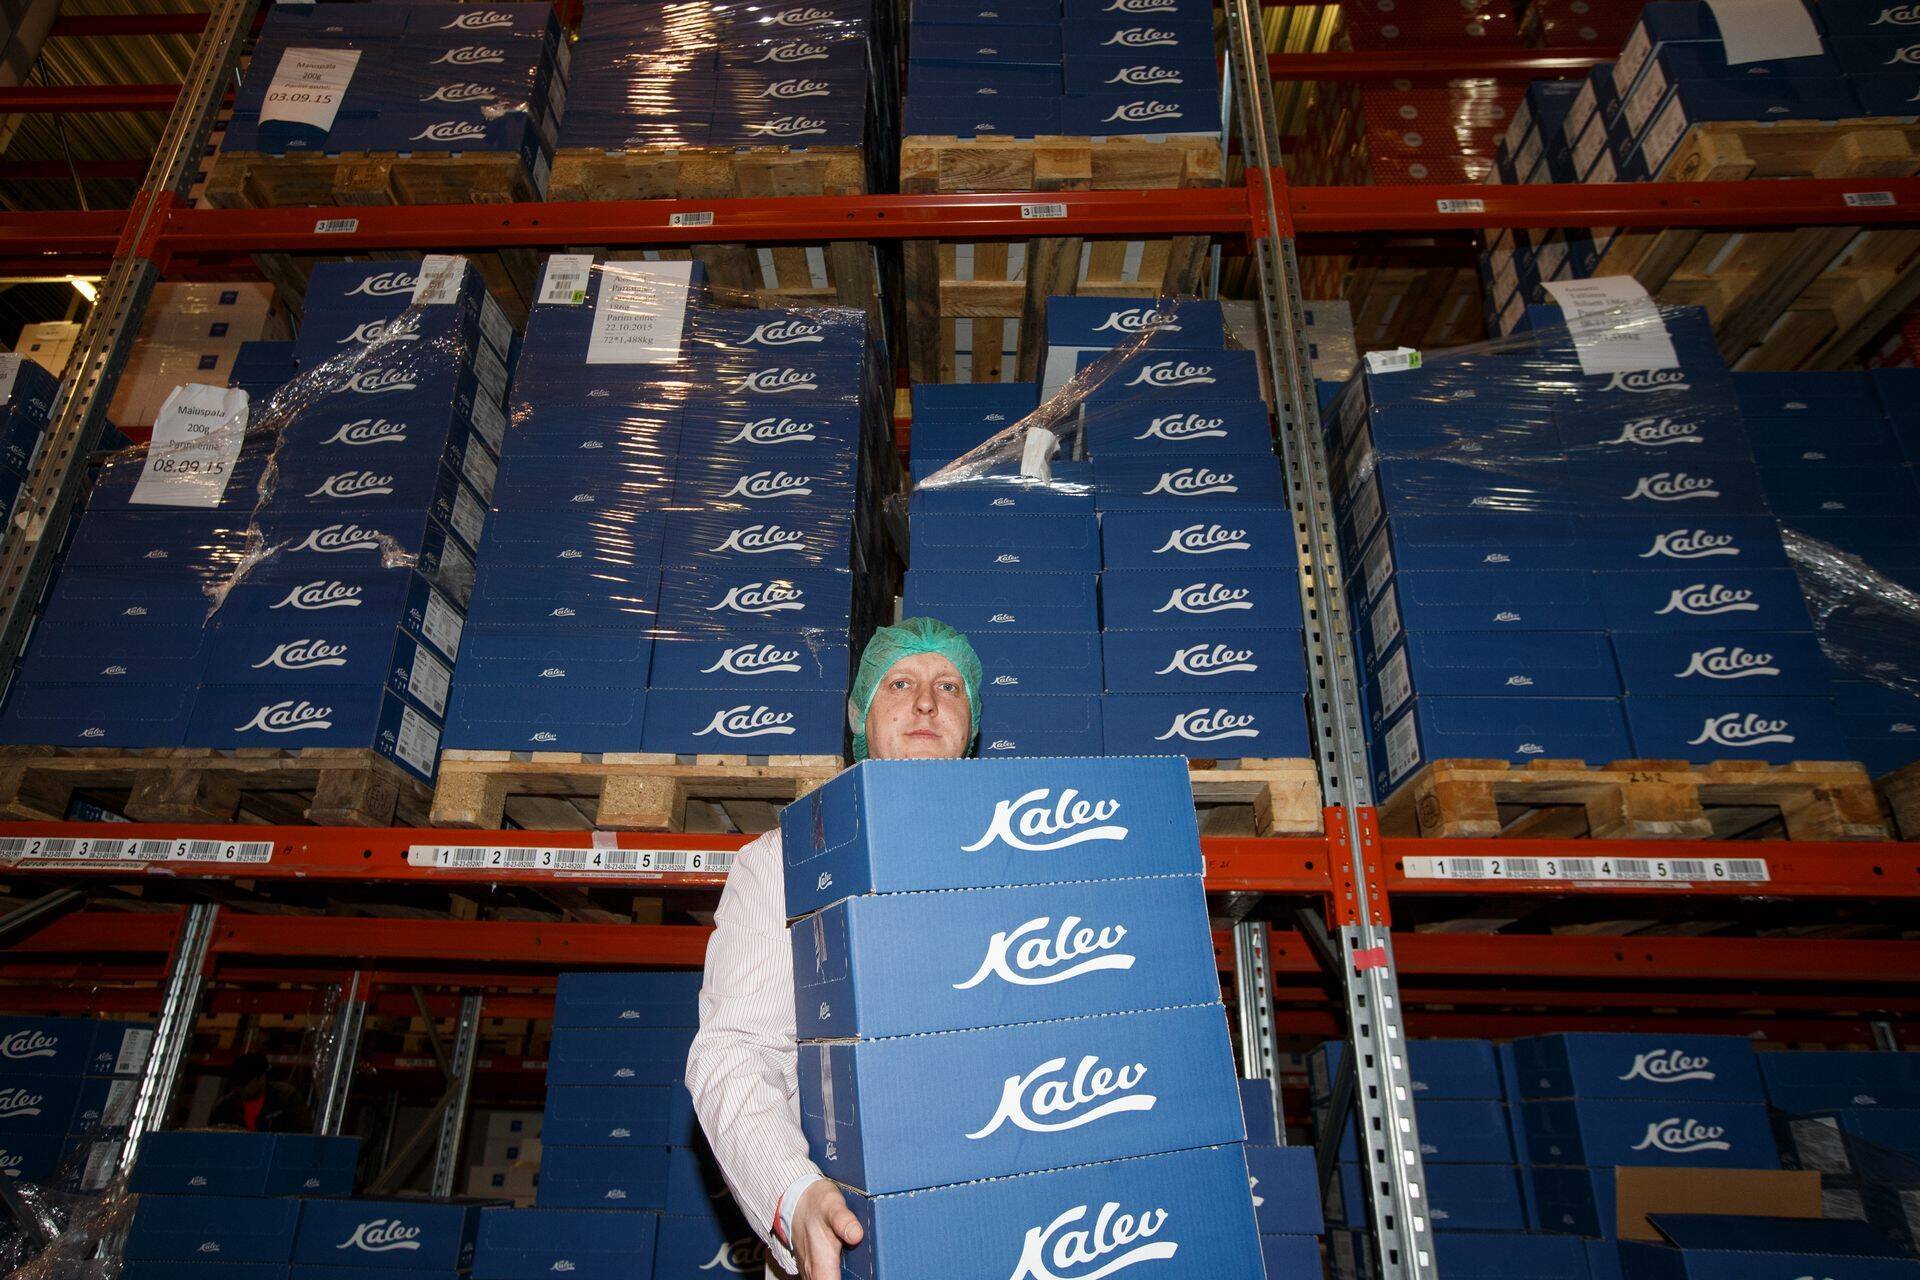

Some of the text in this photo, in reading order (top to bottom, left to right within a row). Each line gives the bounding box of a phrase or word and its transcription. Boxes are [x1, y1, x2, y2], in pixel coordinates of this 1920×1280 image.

[440, 11, 513, 29] Kalev
[761, 8, 836, 26] Kalev
[1100, 28, 1179, 47] Kalev
[430, 46, 504, 64] Kalev
[753, 43, 830, 63] Kalev
[1104, 66, 1183, 85] Kalev
[269, 92, 332, 104] 03.09.15
[419, 82, 496, 103] Kalev
[752, 79, 830, 99] Kalev
[1101, 101, 1183, 122] Kalev
[409, 121, 486, 140] Kalev
[748, 116, 828, 137] Kalev
[1024, 208, 1030, 216] 3
[1440, 202, 1448, 210] 3
[319, 222, 325, 231] 3
[674, 216, 680, 224] 3
[344, 272, 418, 296] Kale
[605, 323, 653, 332] 22.10.2015
[607, 314, 632, 322] Parim
[736, 320, 825, 346] Kalev
[335, 368, 417, 394] Kalev
[729, 367, 818, 393] Kalev
[1124, 361, 1216, 388] Kalev
[177, 406, 225, 417] Maiuspala
[187, 423, 210, 435] 200g
[320, 419, 407, 445] Kalev
[722, 417, 816, 450] Kalev
[1133, 414, 1228, 440] Kalev
[1600, 419, 1704, 446] Kalev
[304, 471, 393, 498] Kalev
[718, 471, 812, 499] Kalev
[1142, 468, 1239, 496] Kalev
[1621, 472, 1720, 501] Kalev
[289, 524, 383, 553] Kalev
[708, 524, 806, 553] Kalev
[1152, 524, 1251, 554] Kalev
[1638, 529, 1740, 559] Kalev
[269, 581, 362, 610] Kalev
[706, 583, 806, 612] Kalev
[1153, 583, 1255, 613] Kalev
[1654, 584, 1760, 615] Kalev
[251, 639, 347, 669] Kalev
[700, 644, 802, 675] Kalev
[1154, 644, 1258, 675] Kalev
[1674, 647, 1781, 679] Kalev
[234, 700, 332, 732] Kalev
[692, 705, 796, 737] Kalev
[1154, 708, 1260, 741] Kalev
[1687, 712, 1796, 746] Kalev
[960, 787, 1129, 852] Kalev
[30, 841, 235, 859] 2 3 4 5 6
[443, 850, 701, 869] 1 2 3 4 5 6
[816, 871, 833, 892] Kalev
[1437, 860, 1445, 875] 1
[1491, 860, 1501, 875] 2
[1546, 861, 1556, 876] 3
[1602, 862, 1611, 875] 4
[1657, 863, 1667, 877] 5
[1714, 863, 1723, 877] 6
[952, 917, 1136, 990] Kalev
[818, 1001, 832, 1020] Kalev
[1618, 1049, 1716, 1083] Kalev
[965, 1057, 1157, 1139] Kalev
[1631, 1118, 1731, 1152] Kalev
[336, 1219, 420, 1251] Kalev
[1009, 1201, 1179, 1280] Kalev
